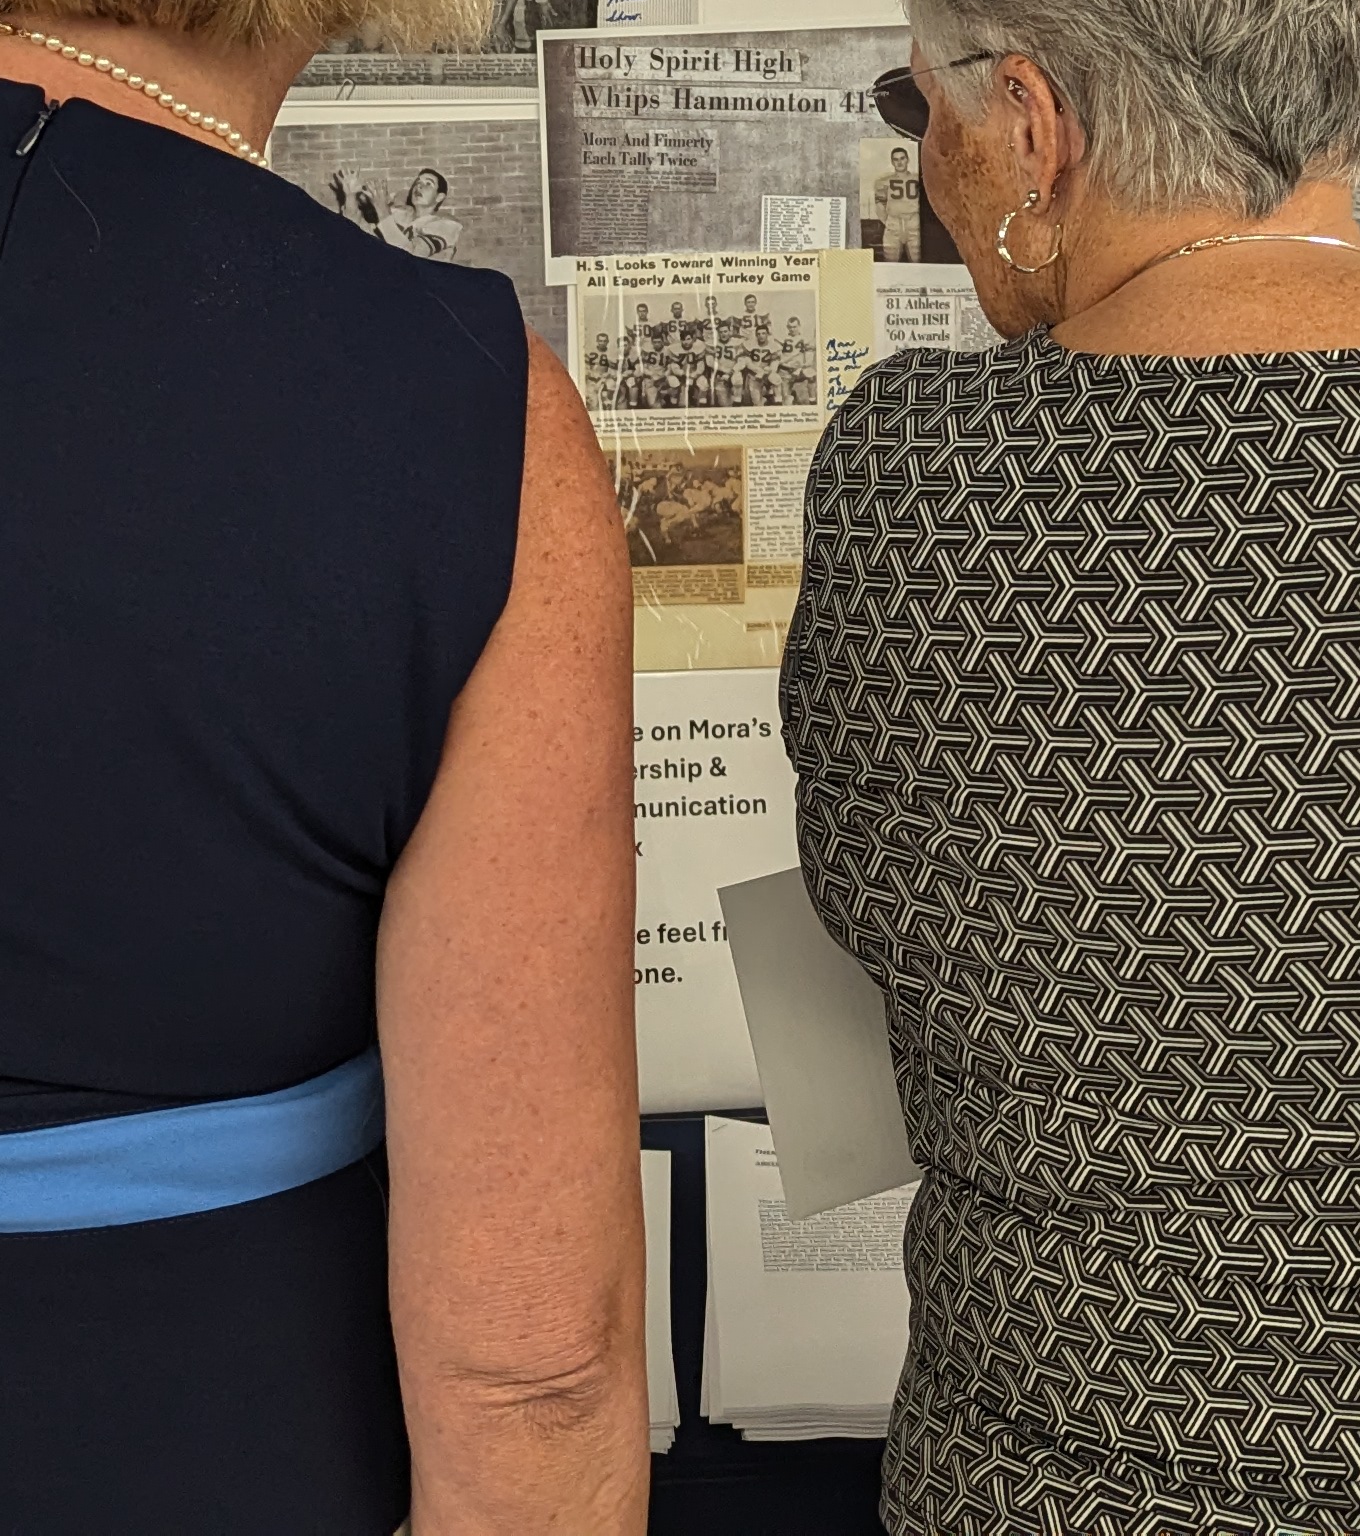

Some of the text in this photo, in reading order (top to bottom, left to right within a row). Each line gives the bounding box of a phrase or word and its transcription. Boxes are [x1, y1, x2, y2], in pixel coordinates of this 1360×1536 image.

[578, 45, 794, 78] Holy Spirit High
[580, 85, 661, 120] Whips
[672, 87, 828, 114] Hammonton
[582, 132, 714, 152] Mora And Finnerty
[582, 150, 698, 168] Each Tally Twice
[577, 261, 591, 272] H.
[594, 260, 609, 272] S.
[615, 259, 656, 271] Looks
[662, 258, 714, 270] Toward
[720, 256, 777, 269] Winning
[587, 271, 811, 289] All Eagerly Await Turkey Game
[886, 297, 951, 310] 81 Athletes
[886, 313, 950, 326] Given HSH
[886, 329, 950, 342] '60 Awards
[650, 717, 772, 741] on Mora's
[709, 756, 727, 778] &
[657, 921, 707, 944] feel
